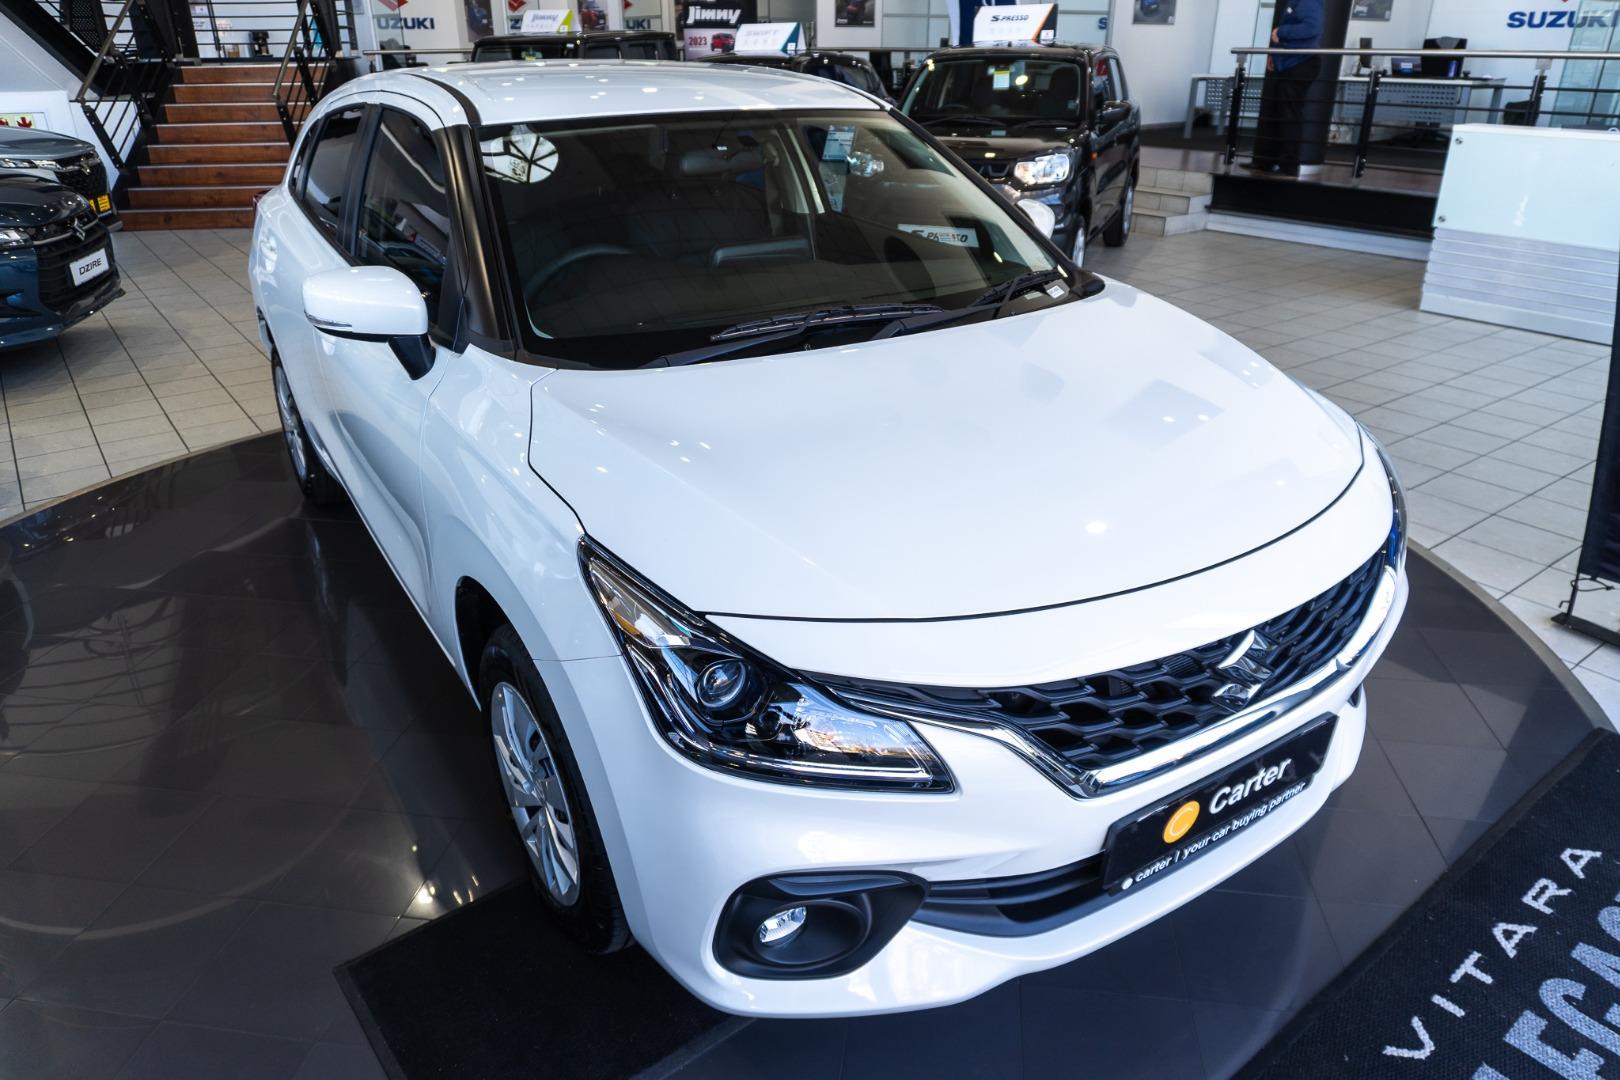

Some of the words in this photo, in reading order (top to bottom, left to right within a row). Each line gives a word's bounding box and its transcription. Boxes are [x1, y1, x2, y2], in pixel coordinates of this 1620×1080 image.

[376, 17, 435, 30] UZUKI
[686, 5, 741, 24] Jimny
[688, 36, 708, 46] 2023
[79, 258, 102, 276] DZIRE
[1209, 757, 1292, 814] Carter
[1135, 855, 1172, 883] carter
[1182, 836, 1211, 860] your
[1211, 824, 1231, 842] car
[1231, 805, 1268, 830] buying
[1268, 782, 1306, 812] partner
[1382, 848, 1603, 1061] VITARA
